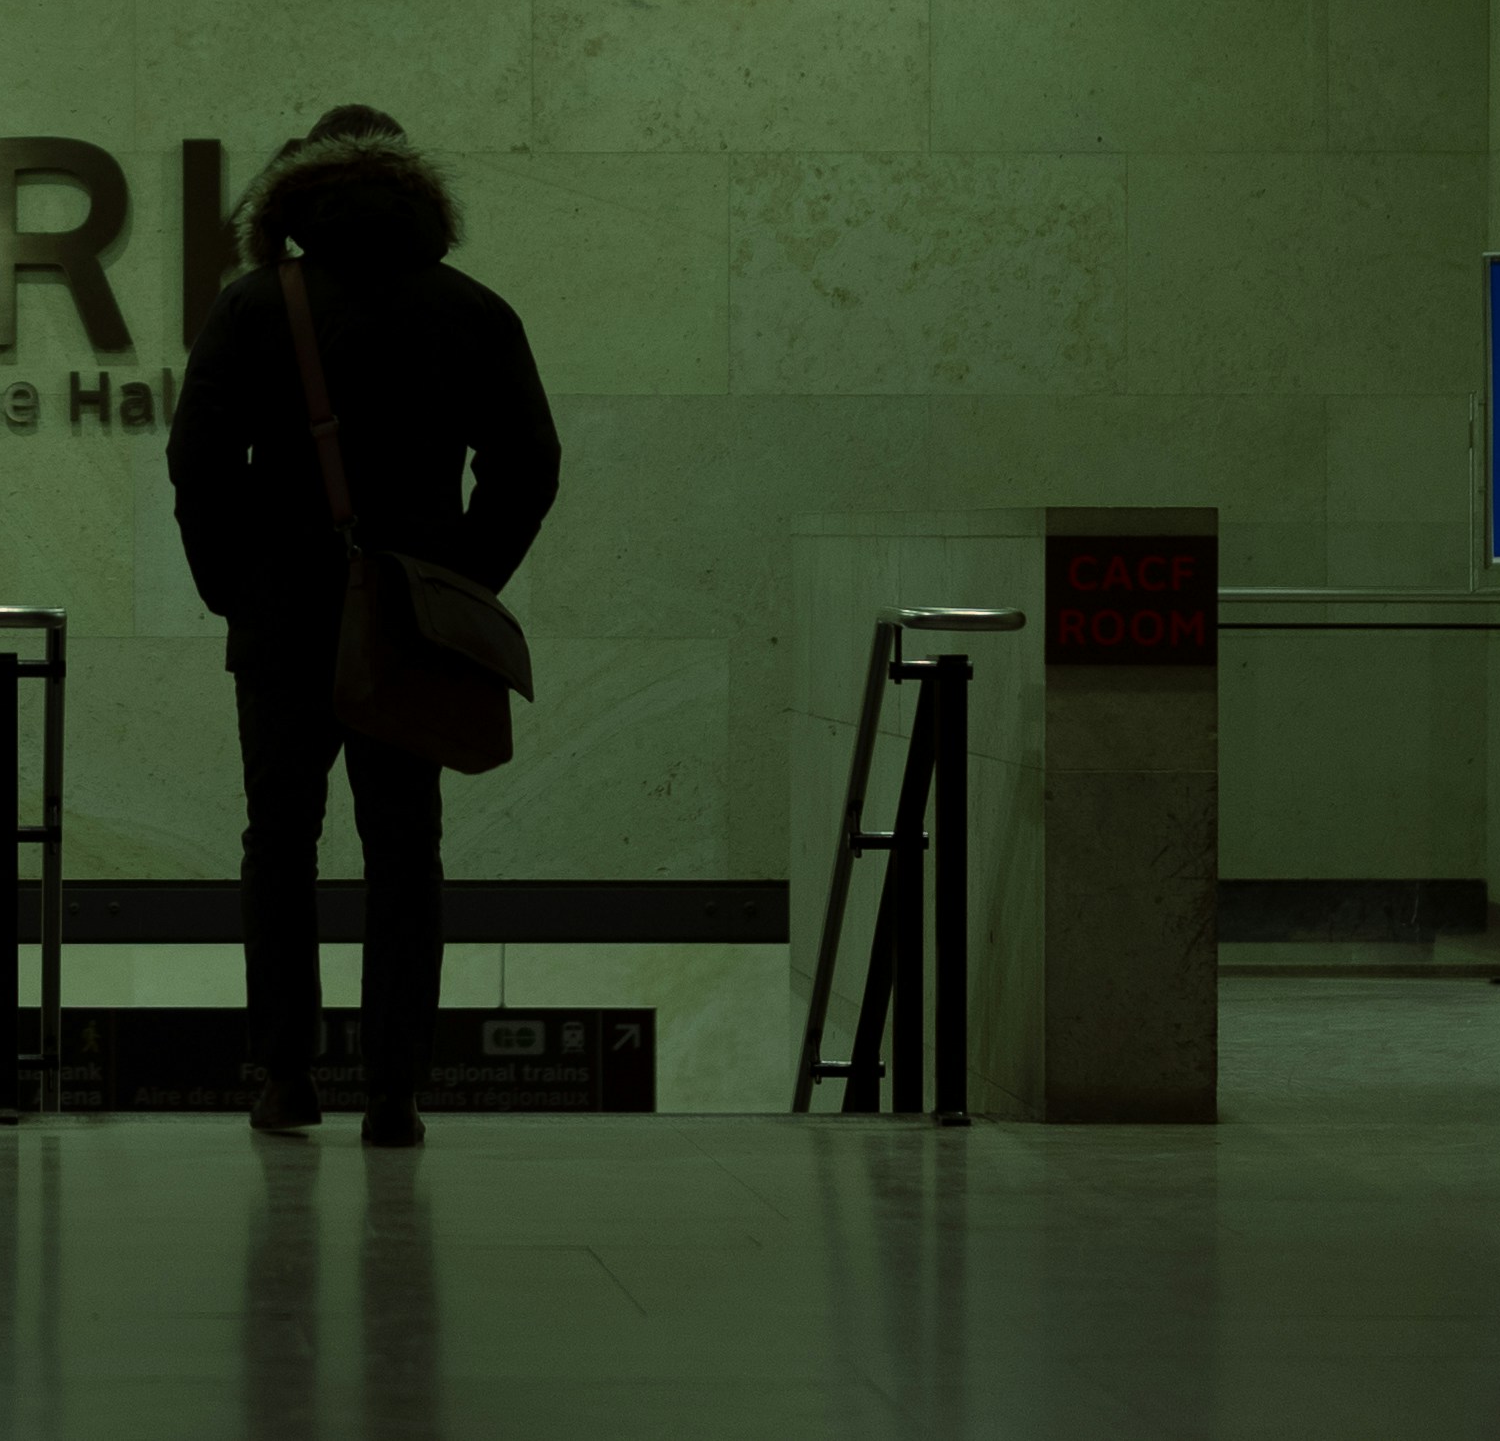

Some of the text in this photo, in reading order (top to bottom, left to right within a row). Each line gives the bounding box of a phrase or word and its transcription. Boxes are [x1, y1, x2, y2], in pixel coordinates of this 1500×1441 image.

[1066, 552, 1198, 592] CACF
[1056, 607, 1207, 649] ROOM
[428, 1062, 591, 1087] egional trains
[133, 1086, 182, 1106] Aire
[187, 1085, 217, 1106] de
[413, 1087, 590, 1108] rains régionaux
